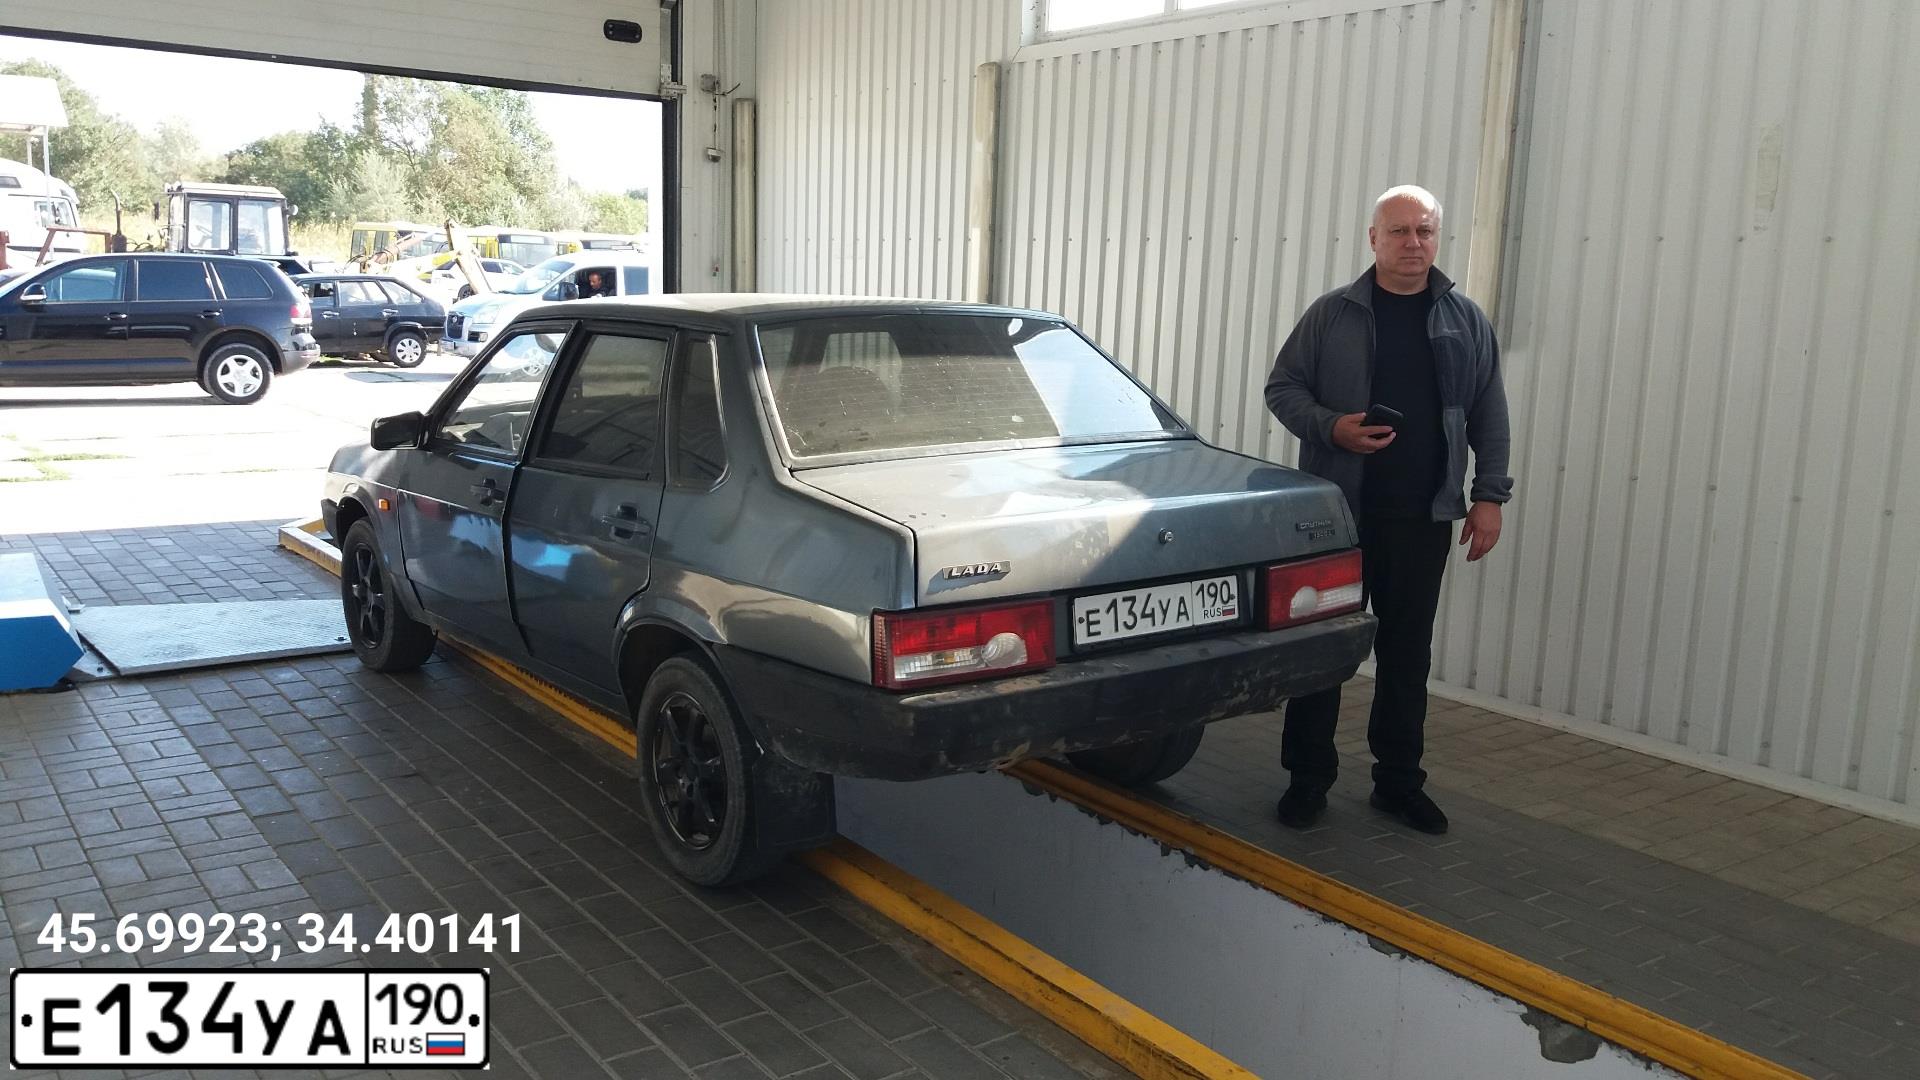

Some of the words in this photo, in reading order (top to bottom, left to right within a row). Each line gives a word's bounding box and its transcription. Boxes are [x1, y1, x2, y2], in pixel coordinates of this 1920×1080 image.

[951, 562, 1002, 577] LADA
[1085, 592, 1190, 637] Е134УА
[1195, 580, 1231, 608] 190
[1203, 608, 1222, 619] RUS
